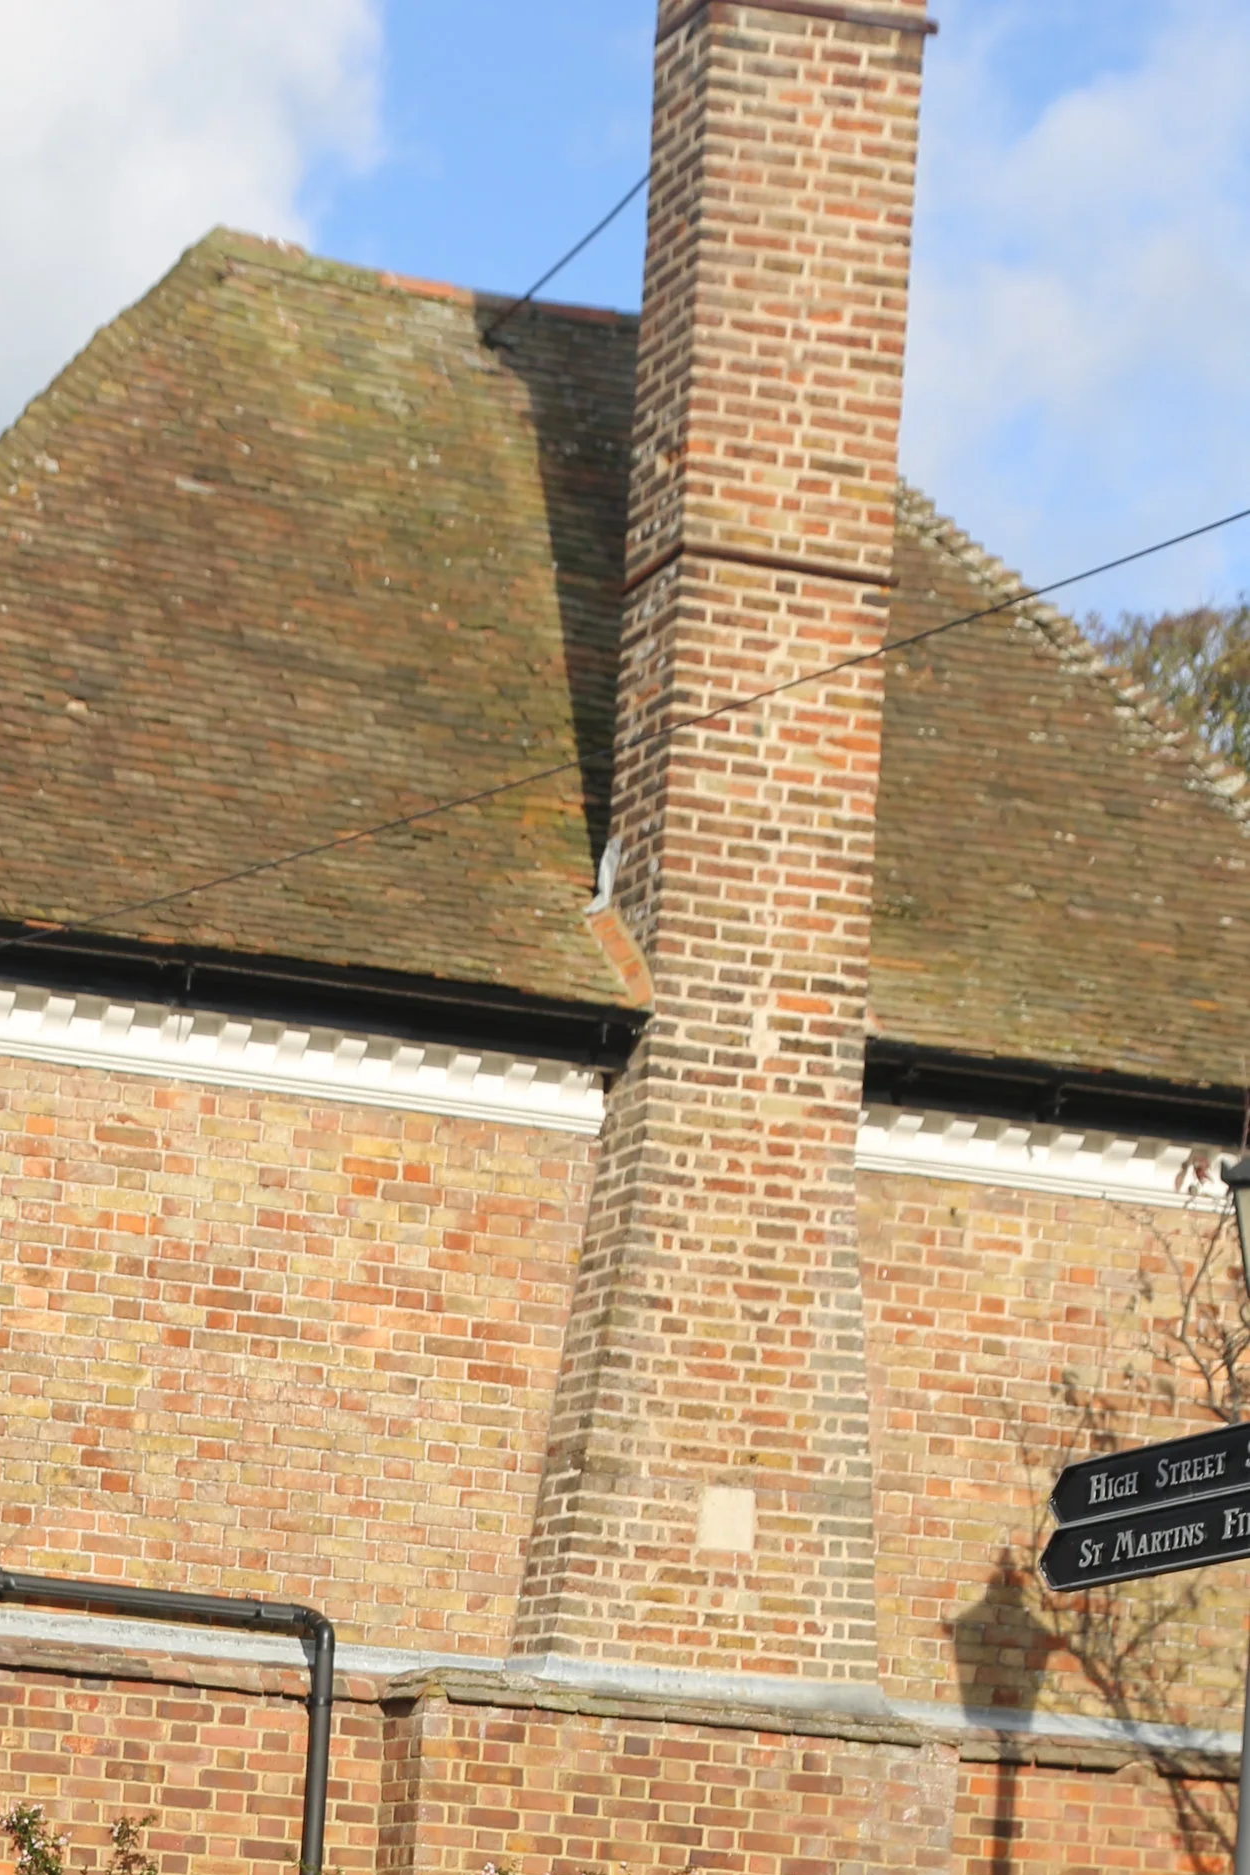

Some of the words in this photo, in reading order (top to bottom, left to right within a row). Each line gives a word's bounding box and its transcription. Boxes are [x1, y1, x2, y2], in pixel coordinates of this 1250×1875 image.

[1088, 1472, 1138, 1505] HIGH
[1155, 1451, 1227, 1489] STREET
[1079, 1539, 1104, 1568] ST
[1111, 1522, 1205, 1563] MARTINS
